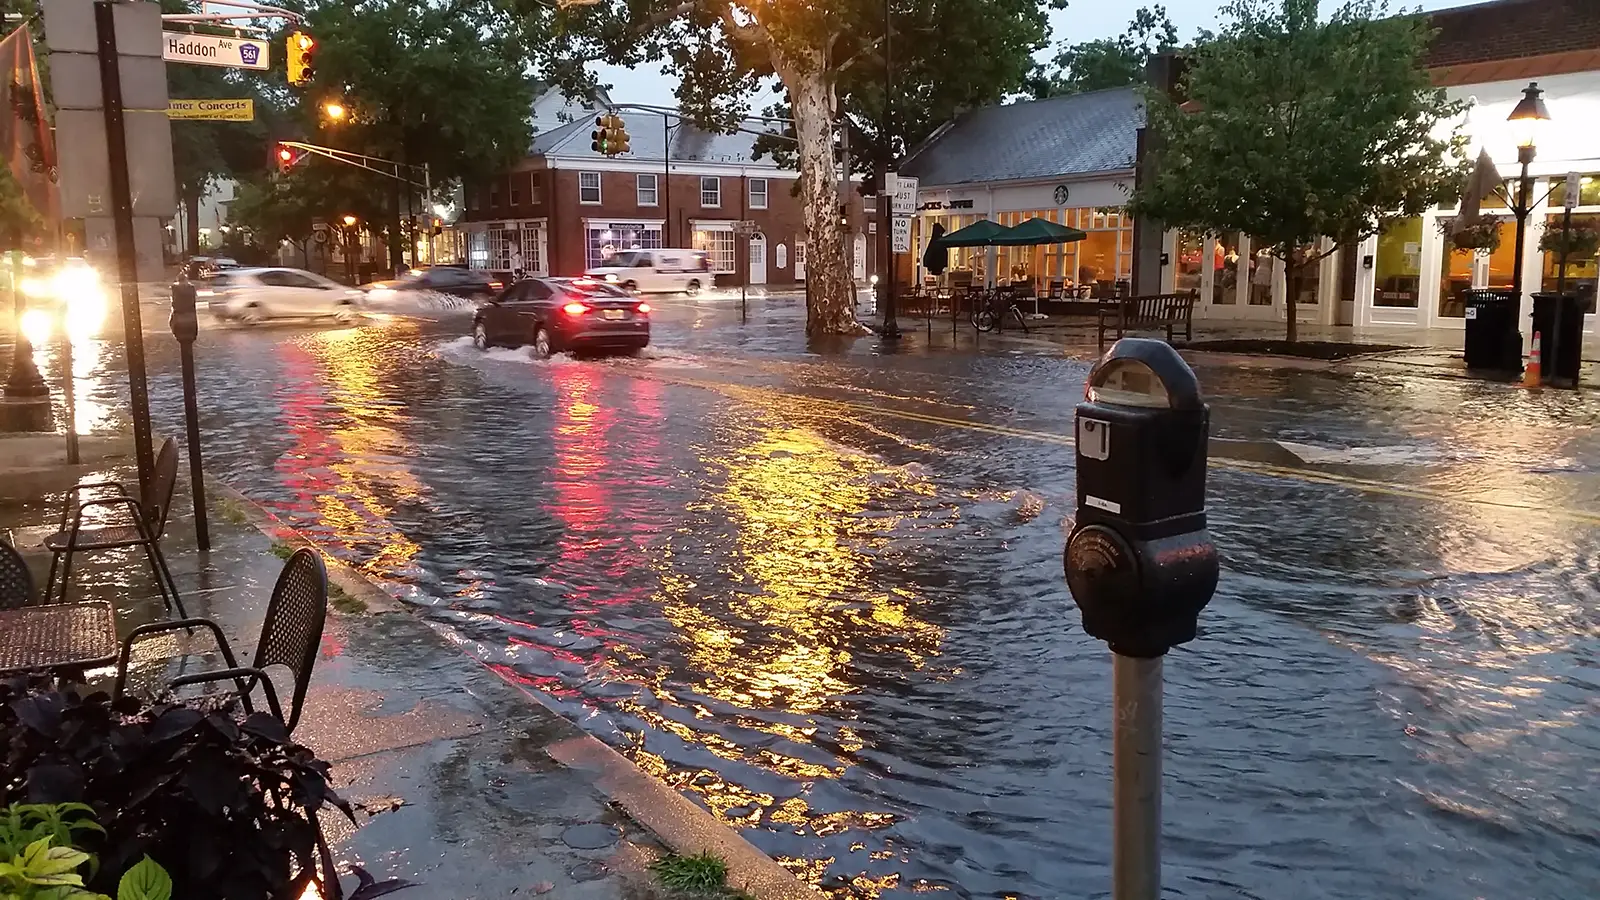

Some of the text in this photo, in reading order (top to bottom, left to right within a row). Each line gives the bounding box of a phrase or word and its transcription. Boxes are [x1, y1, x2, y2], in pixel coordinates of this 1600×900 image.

[169, 38, 233, 58] Haddon Ave
[243, 50, 256, 59] 561
[168, 101, 247, 110] mer Concerts
[903, 182, 916, 190] LANE
[895, 219, 906, 228] NO
